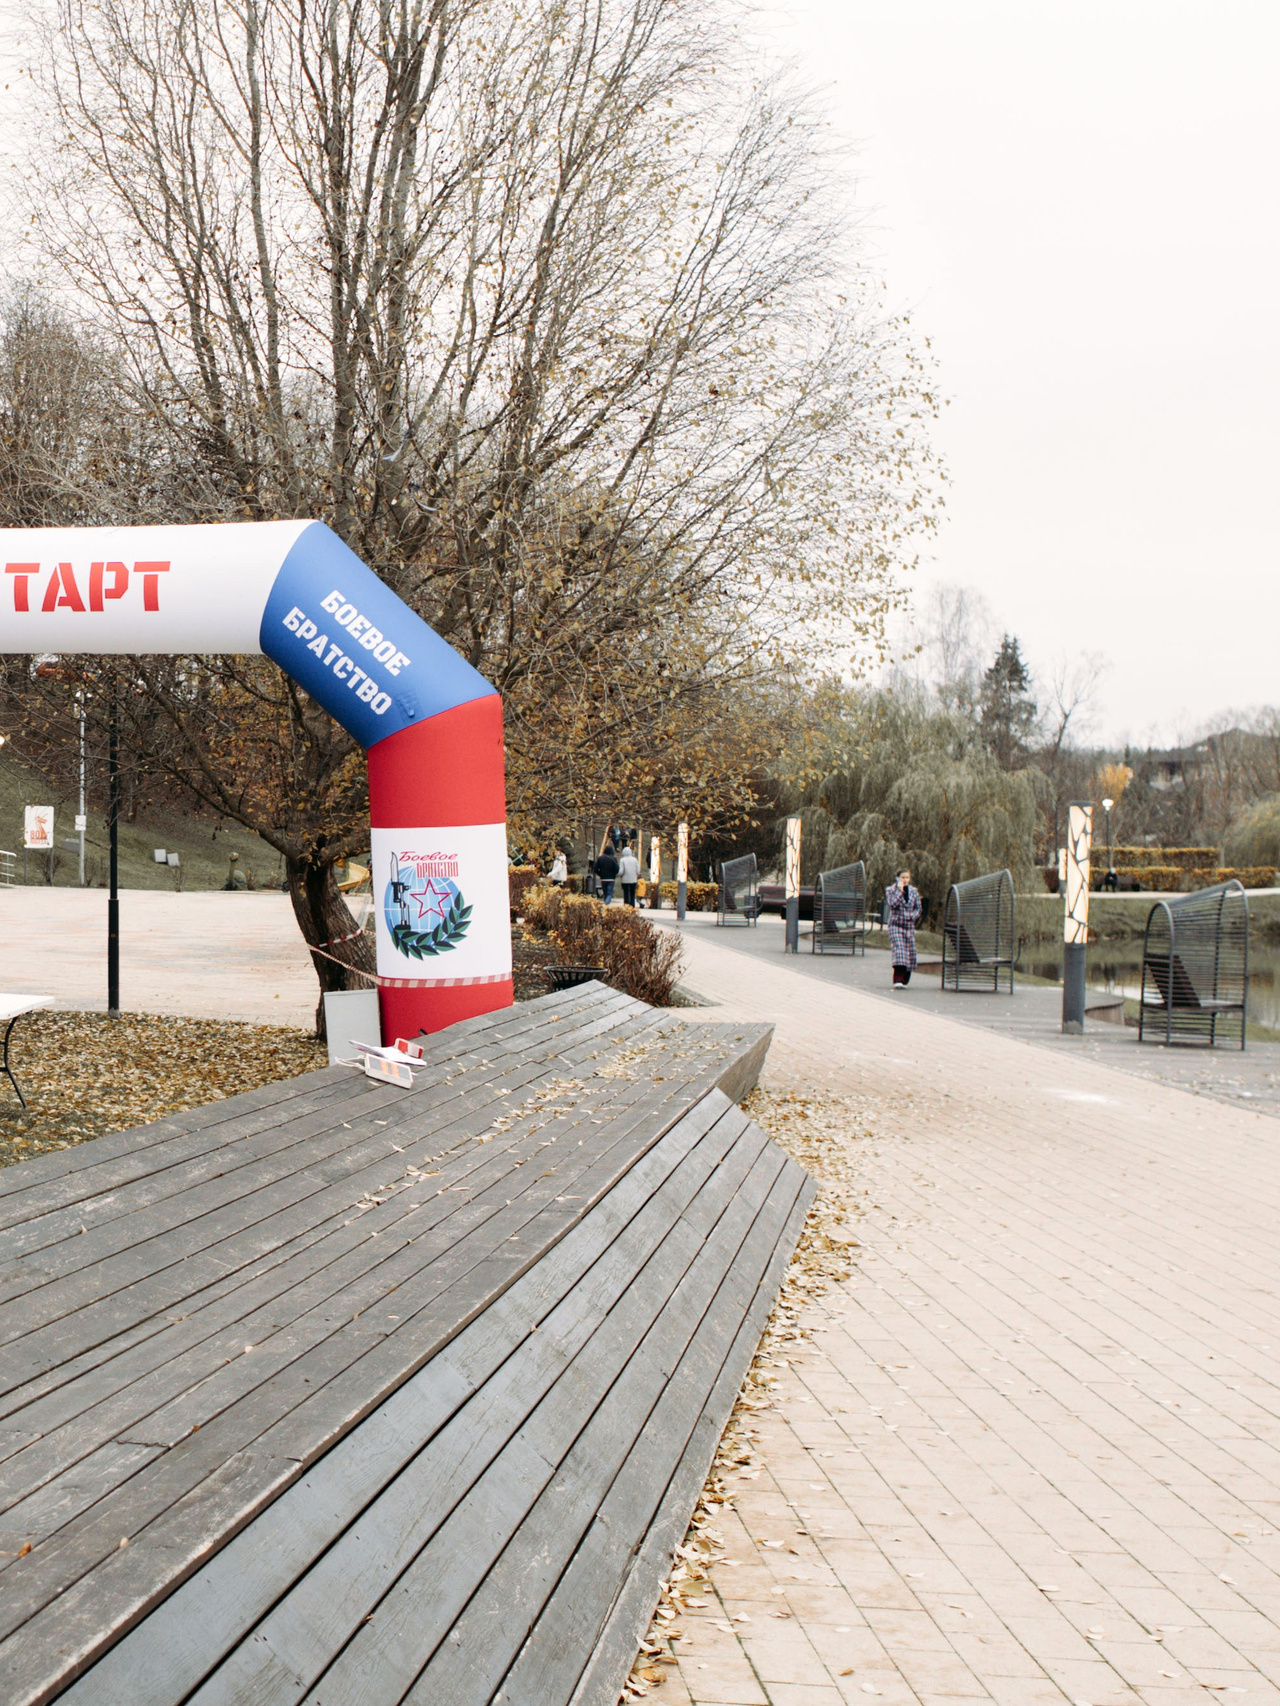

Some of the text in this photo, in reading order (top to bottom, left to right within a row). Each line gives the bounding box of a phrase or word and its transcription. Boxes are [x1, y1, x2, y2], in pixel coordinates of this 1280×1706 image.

[320, 589, 411, 677] БОЕВОЕ
[282, 606, 393, 716] БРАТСТВО
[399, 850, 458, 862] Боевое
[416, 861, 459, 879] БРАТСТВО
